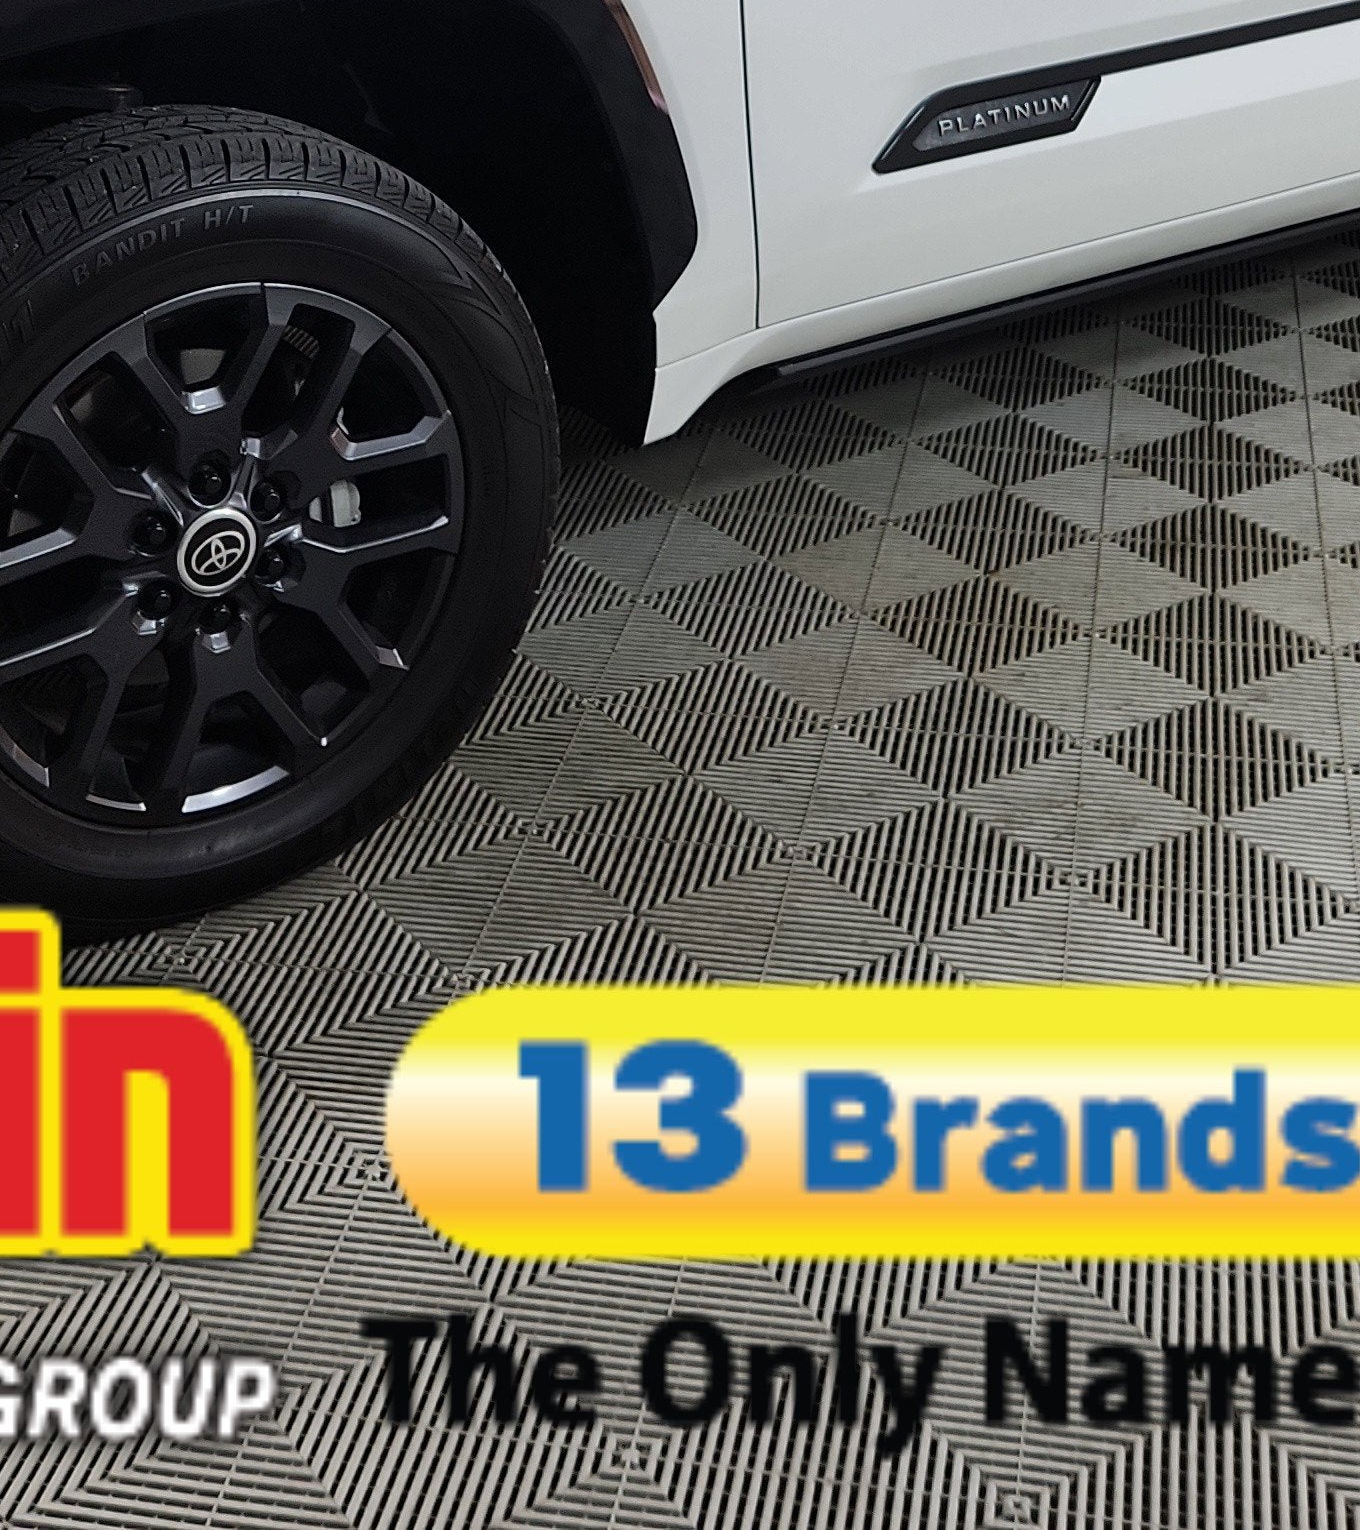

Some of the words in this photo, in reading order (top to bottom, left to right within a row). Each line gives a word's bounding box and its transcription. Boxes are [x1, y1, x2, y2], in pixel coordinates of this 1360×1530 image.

[938, 93, 1070, 138] PLATINUM
[71, 217, 186, 287] BANDIT
[203, 204, 255, 231] H/T
